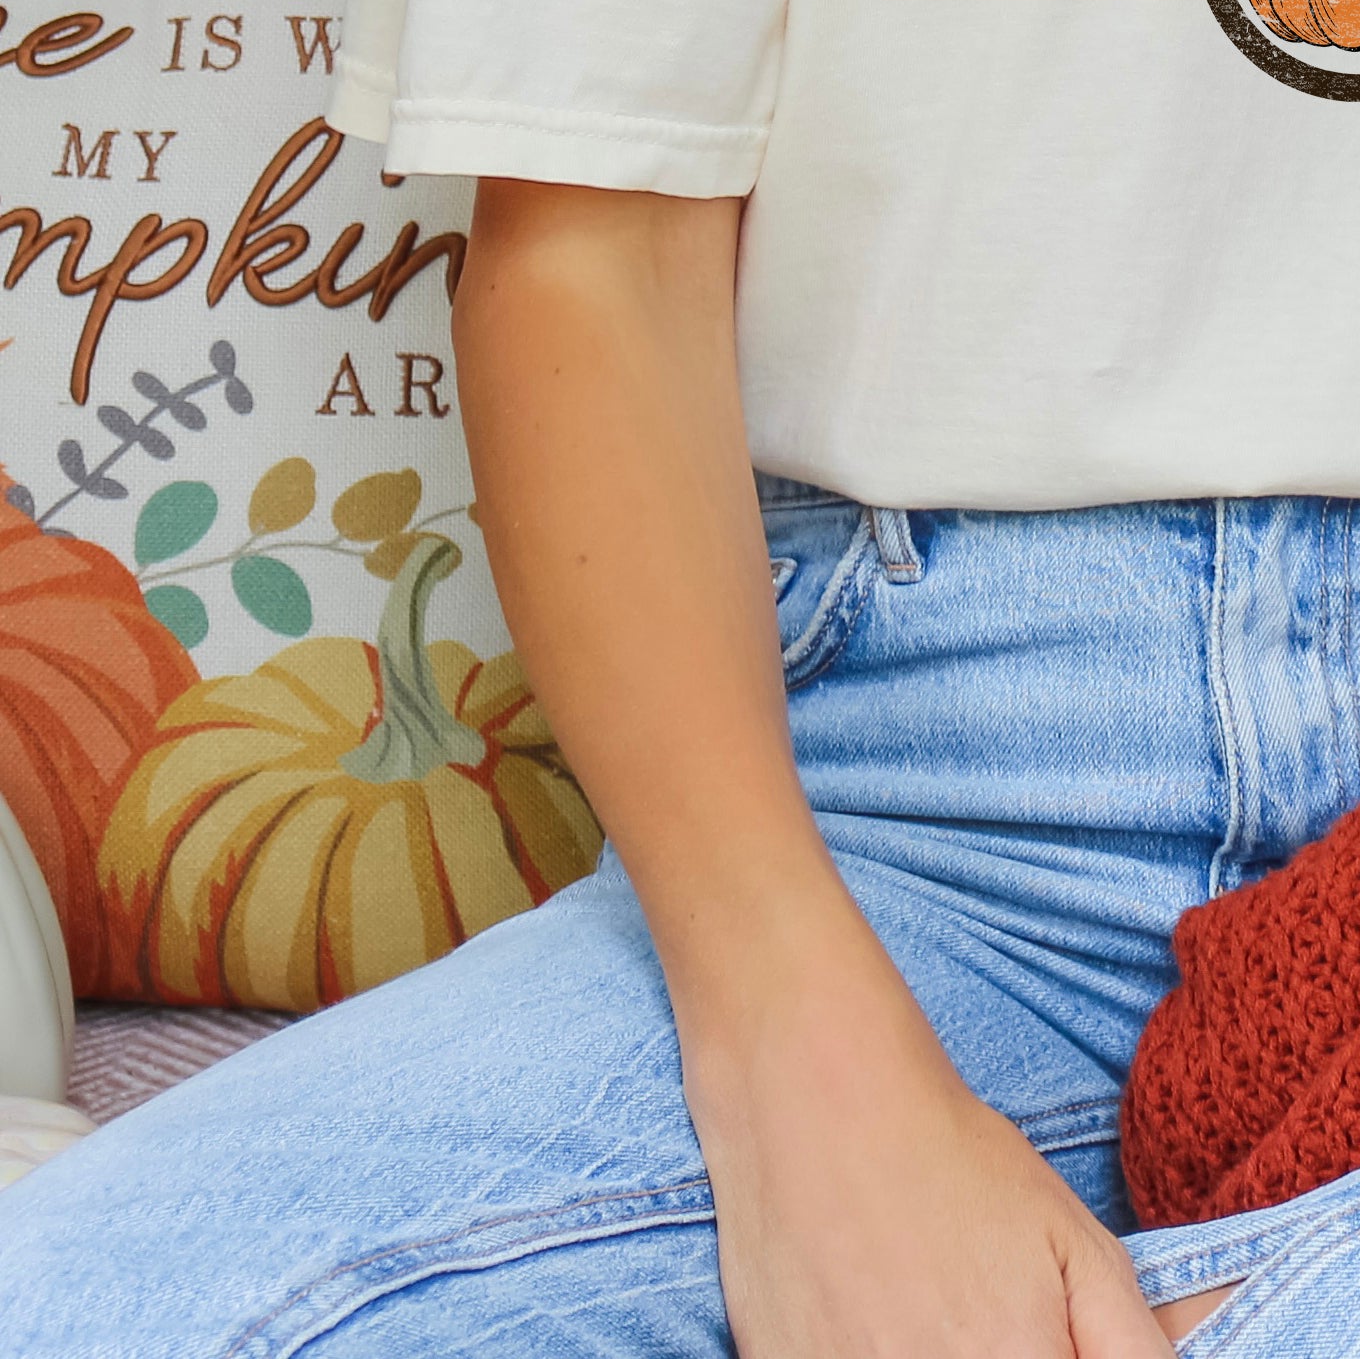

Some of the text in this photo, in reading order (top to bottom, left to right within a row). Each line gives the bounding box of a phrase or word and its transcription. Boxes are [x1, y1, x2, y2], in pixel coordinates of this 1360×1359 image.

[161, 14, 243, 72] IS
[52, 123, 178, 182] MY
[315, 352, 450, 418] AR
